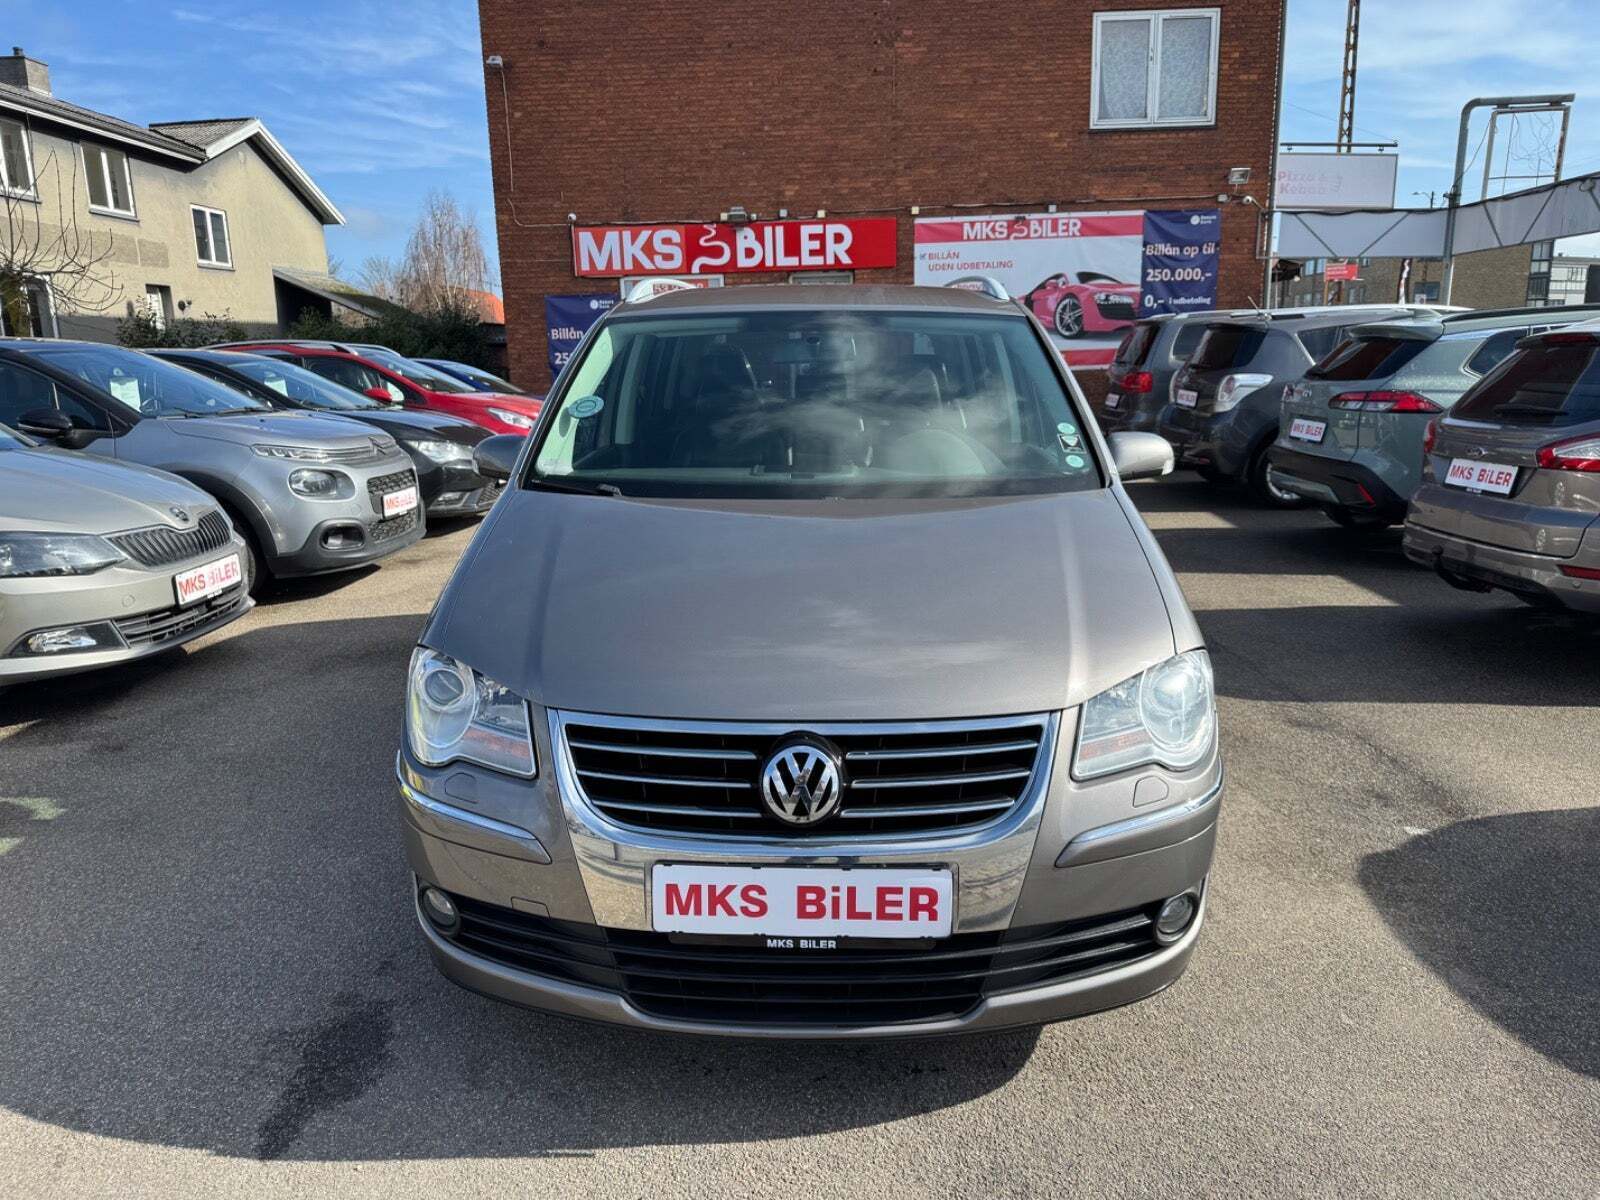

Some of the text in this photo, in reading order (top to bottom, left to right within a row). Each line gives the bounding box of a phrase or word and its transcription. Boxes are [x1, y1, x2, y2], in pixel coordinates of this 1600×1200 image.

[963, 217, 1081, 240] MKS BILER
[578, 223, 853, 271] MKS BILER
[1145, 242, 1216, 258] Billån op til
[928, 251, 960, 261] BILLÅN
[928, 260, 1013, 272] UDEN UDBETALING
[1146, 267, 1212, 282] 250.000,-
[550, 326, 585, 340] Billån
[1450, 464, 1513, 487] MKS BiLER
[178, 573, 206, 602] MKS
[664, 883, 939, 922] MKS BiLER
[767, 939, 794, 949] MKS
